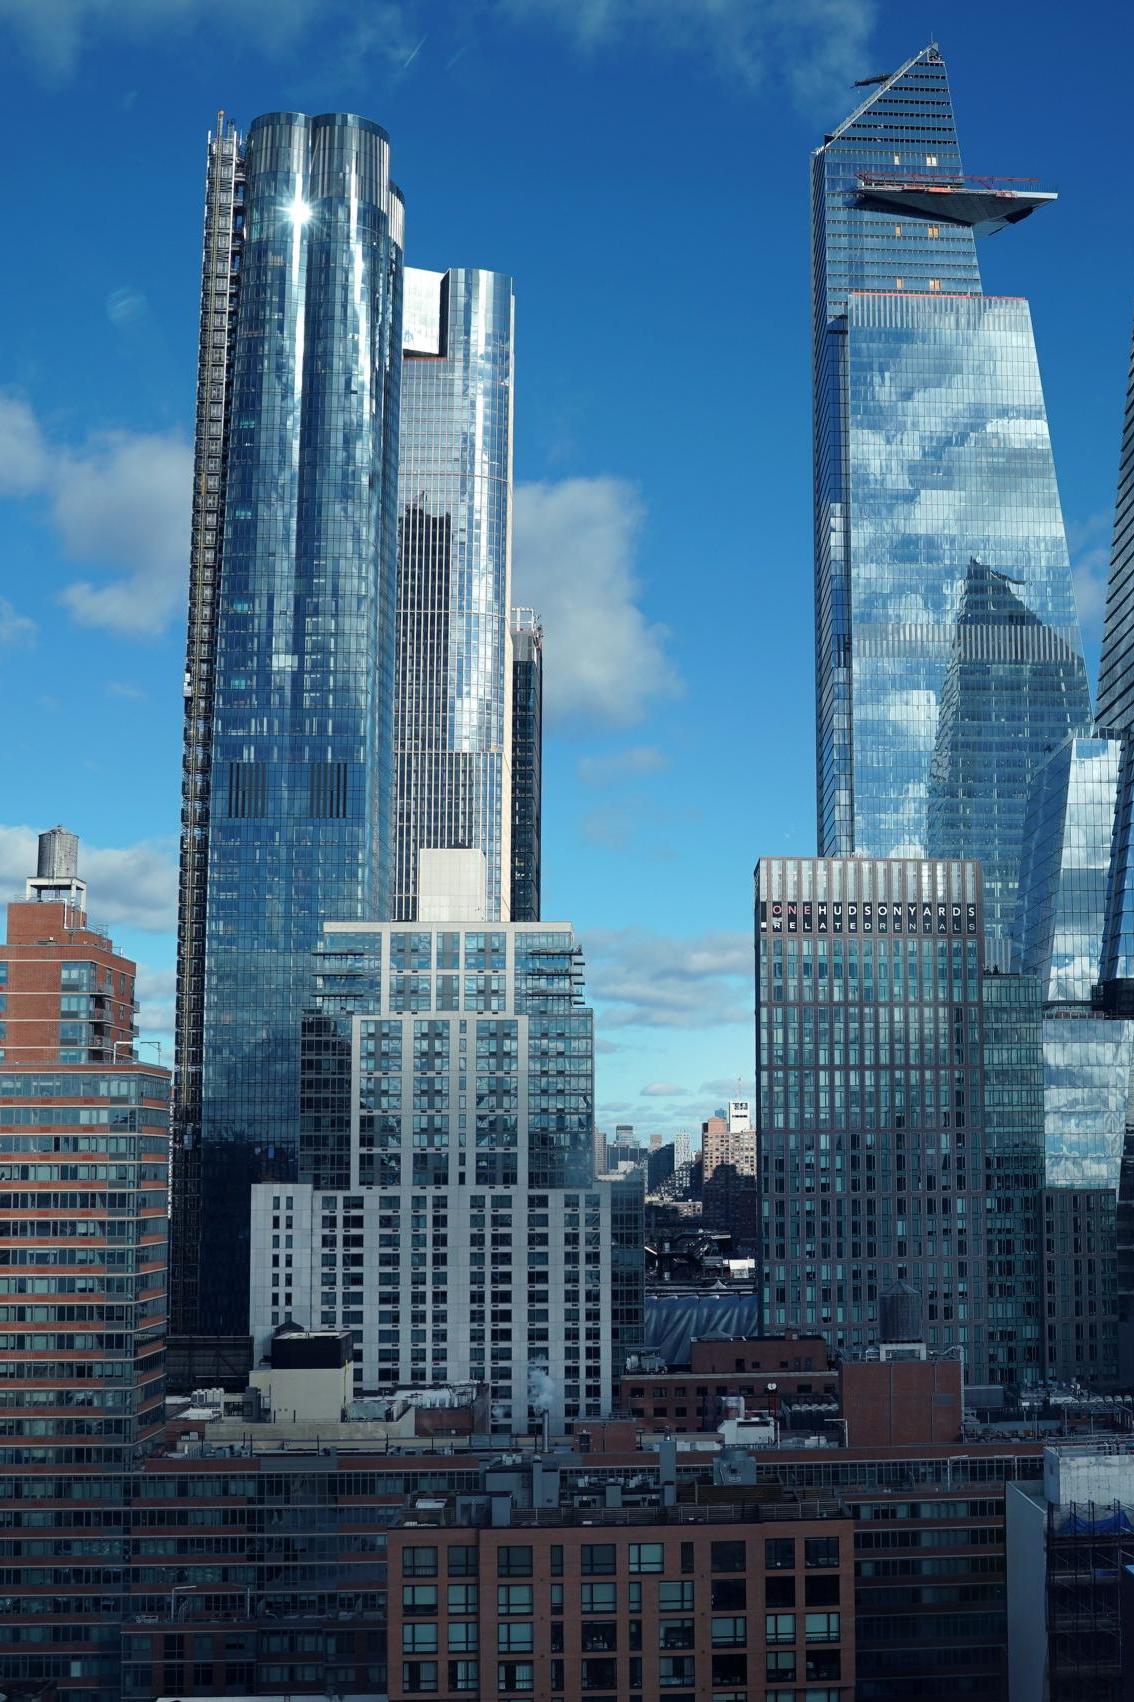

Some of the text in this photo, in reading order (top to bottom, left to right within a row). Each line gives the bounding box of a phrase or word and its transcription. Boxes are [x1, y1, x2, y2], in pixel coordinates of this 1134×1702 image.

[772, 905, 975, 917] ONE HUDSON YARDS
[774, 921, 975, 931] RELATED RENTALS
